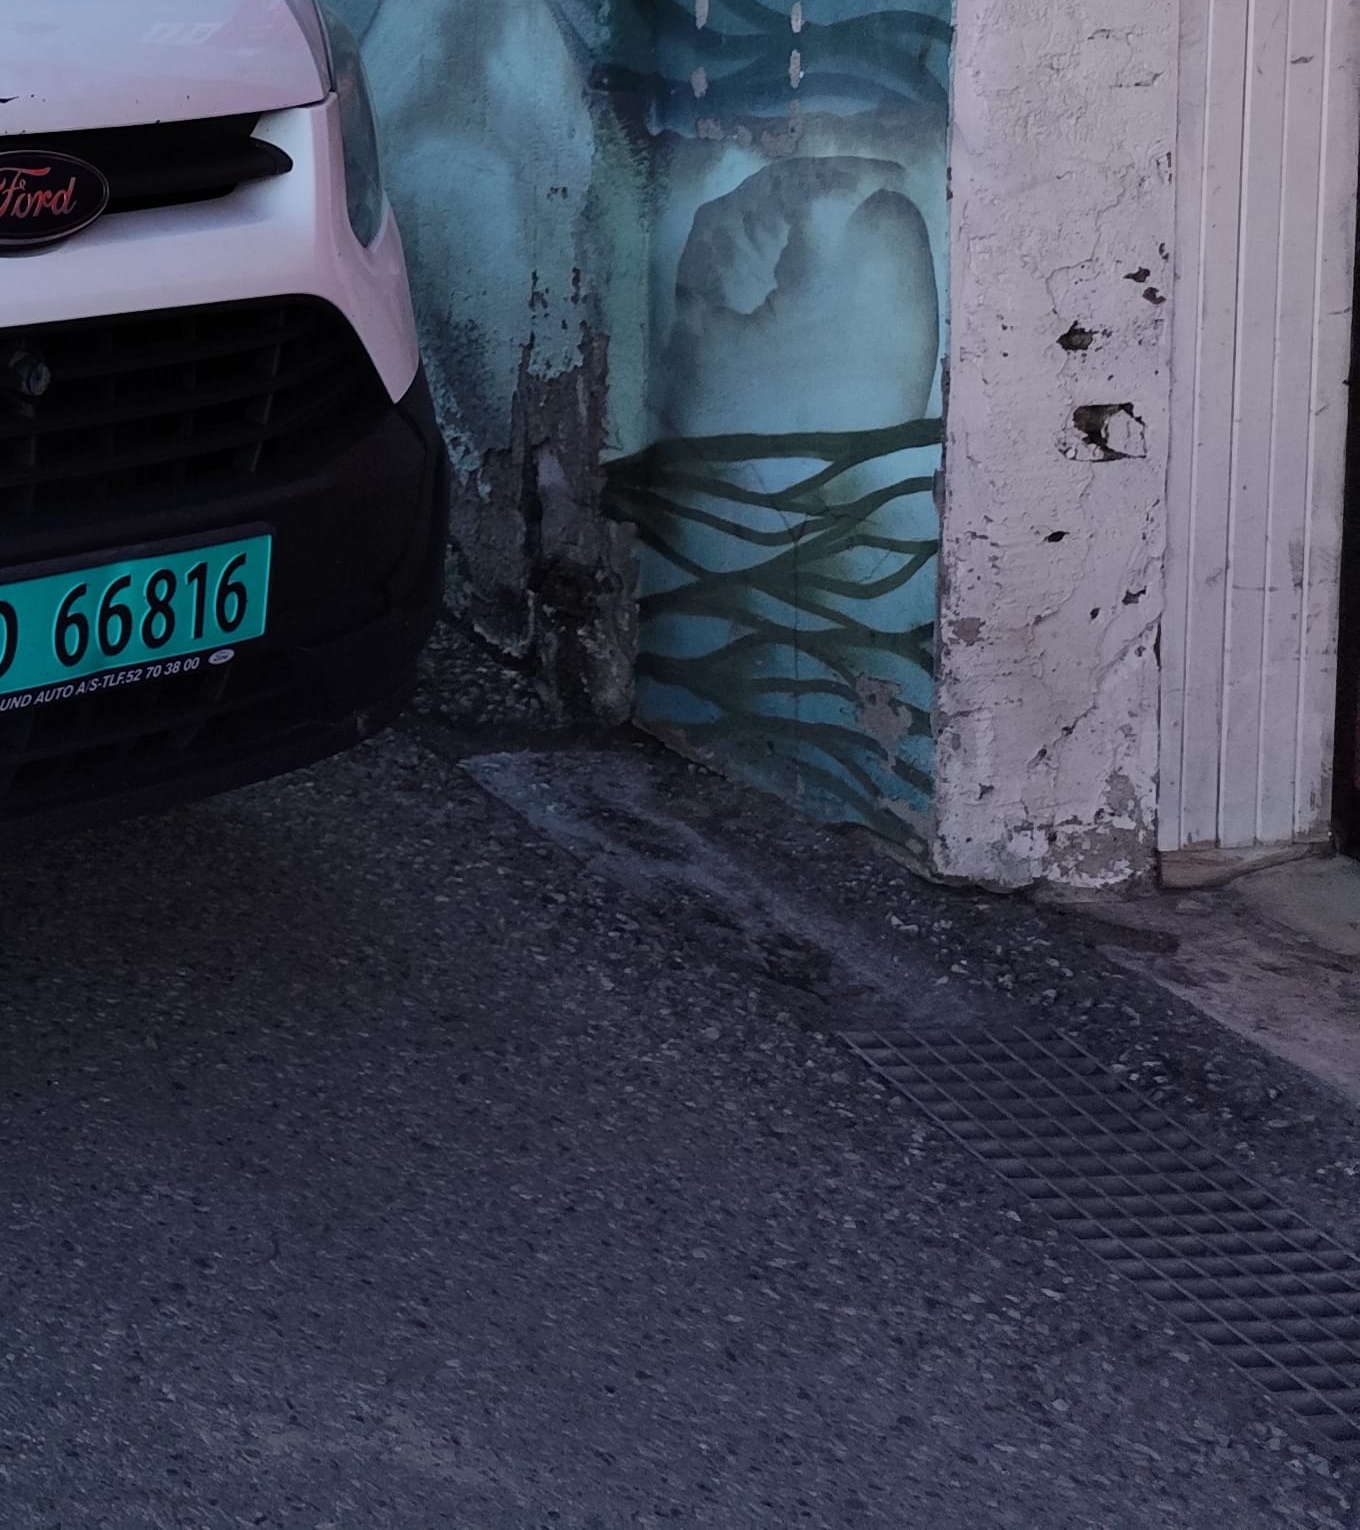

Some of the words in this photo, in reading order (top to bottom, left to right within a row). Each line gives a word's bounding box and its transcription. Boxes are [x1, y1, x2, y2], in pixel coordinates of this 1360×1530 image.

[53, 552, 248, 667] 66816
[33, 684, 74, 706] AUTO
[146, 664, 163, 679] 70
[164, 660, 181, 676] 38
[183, 656, 201, 671] 00
